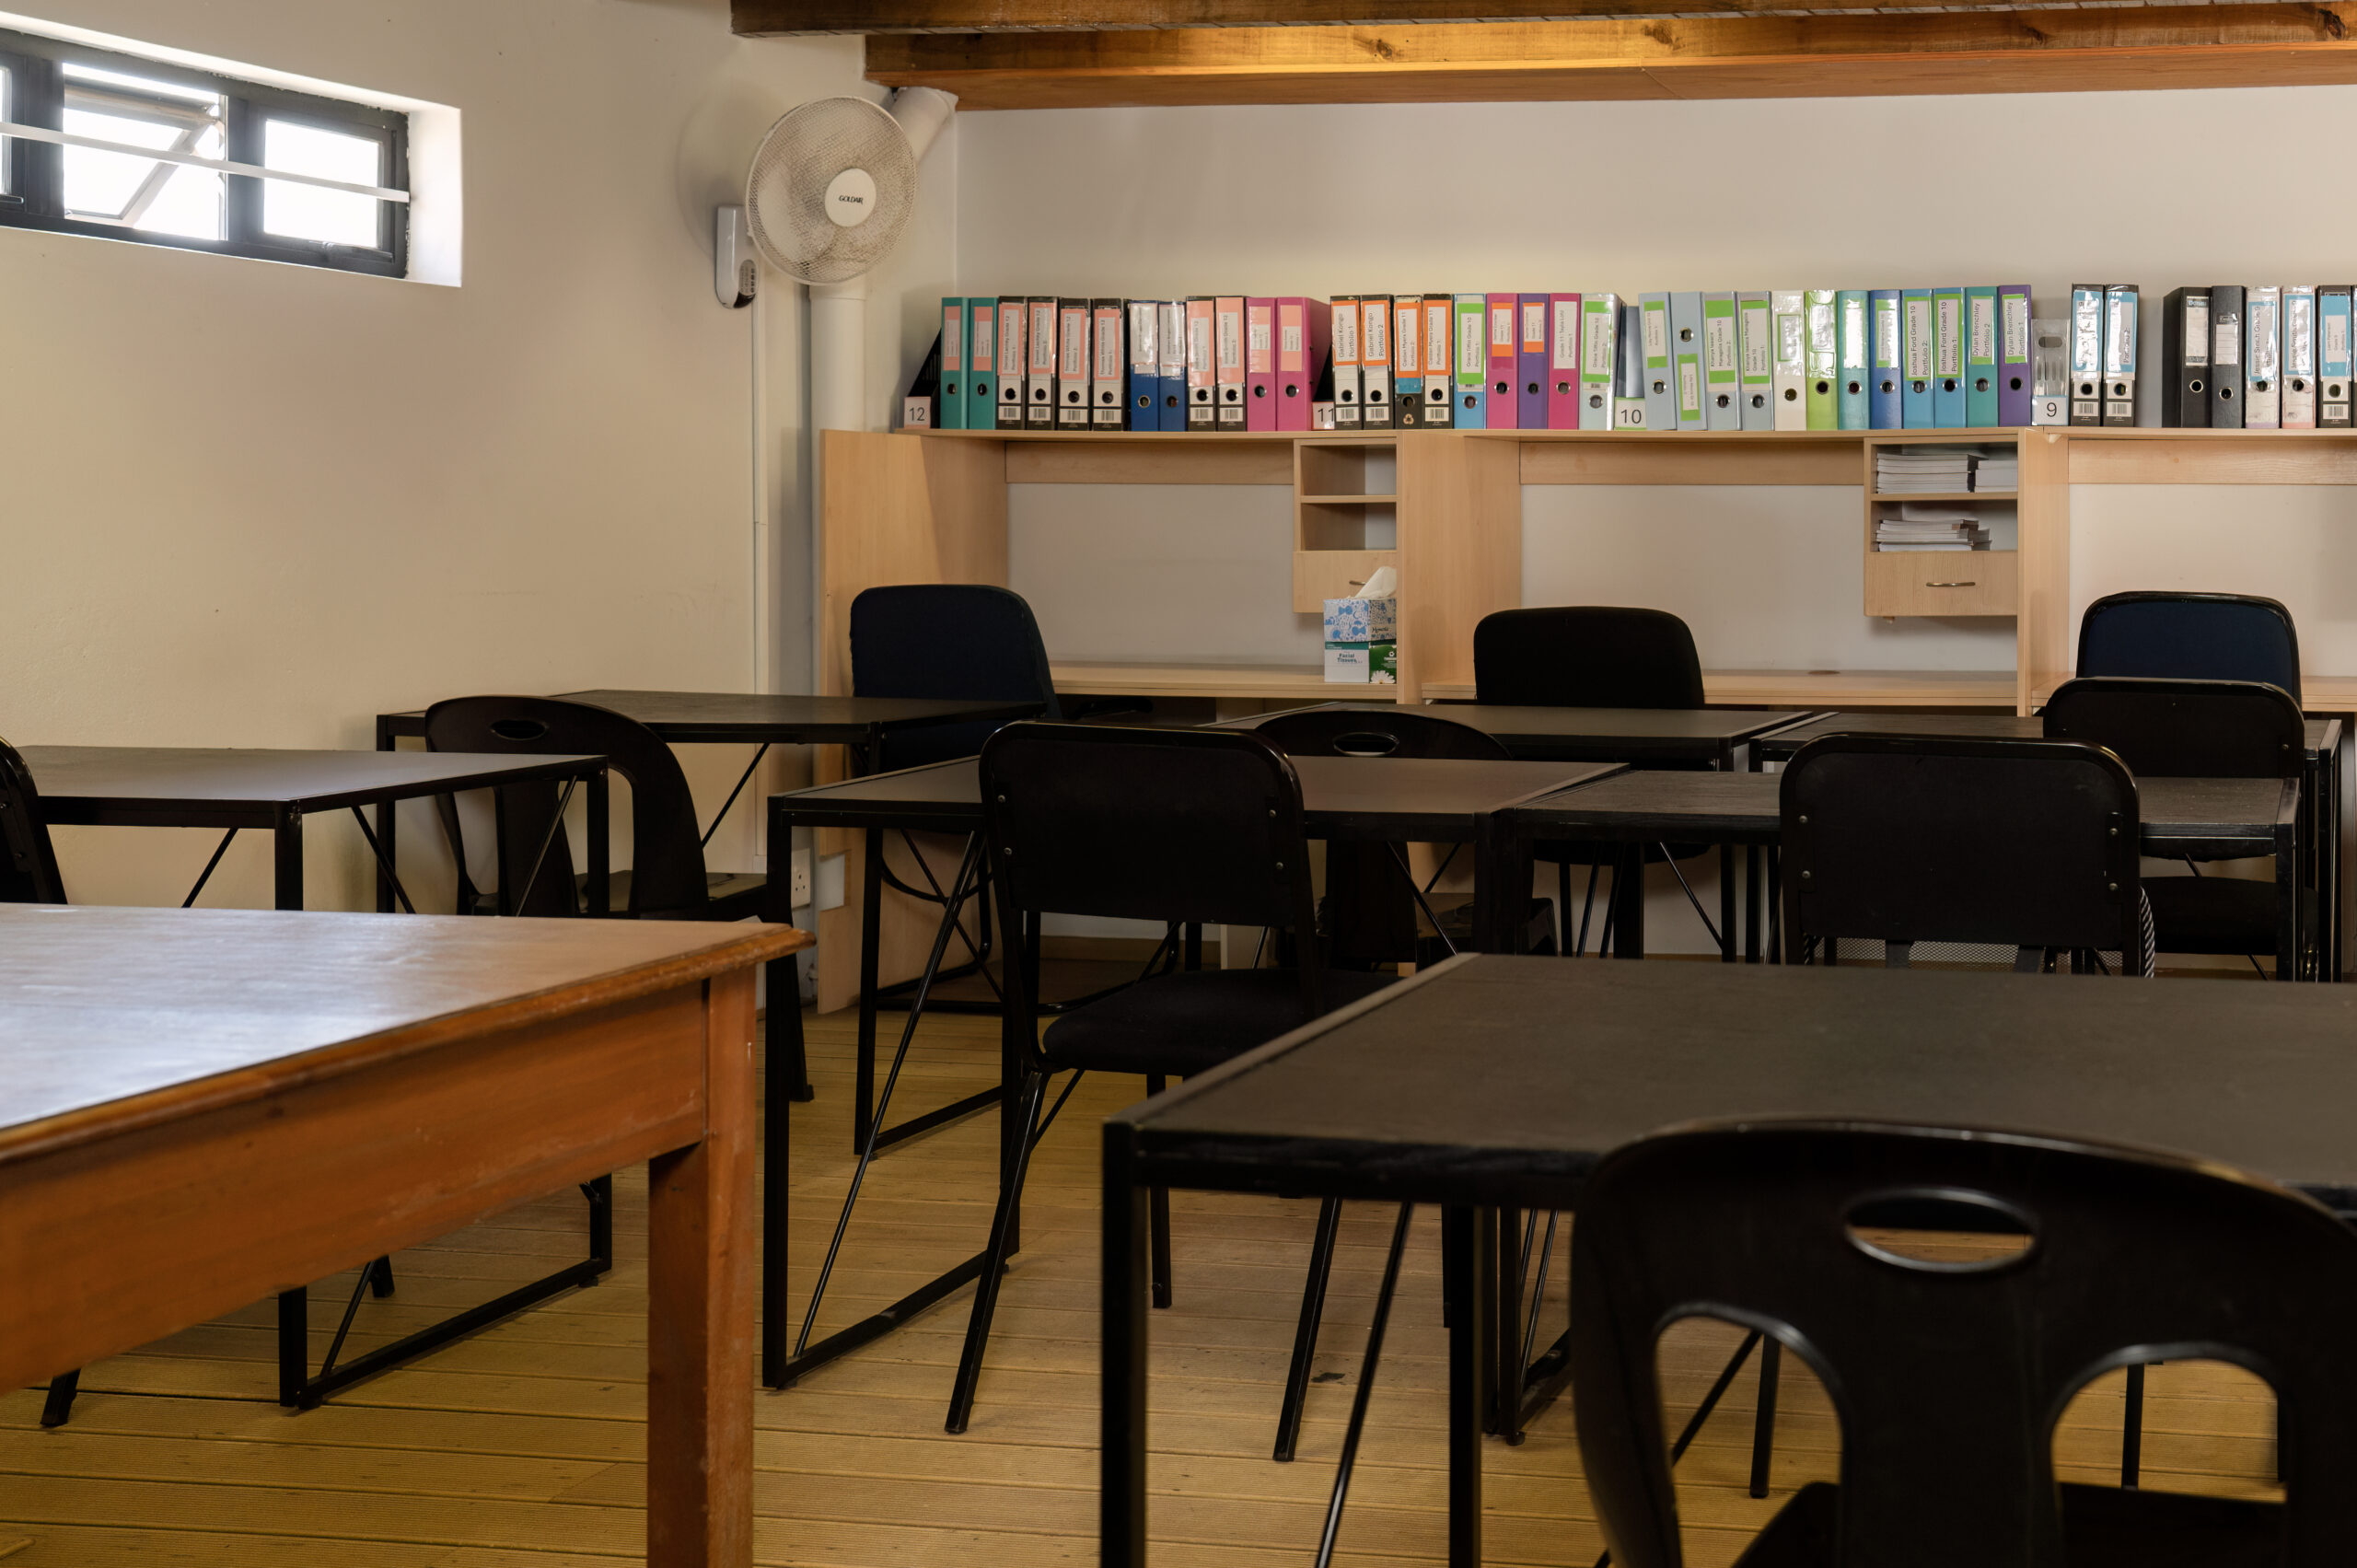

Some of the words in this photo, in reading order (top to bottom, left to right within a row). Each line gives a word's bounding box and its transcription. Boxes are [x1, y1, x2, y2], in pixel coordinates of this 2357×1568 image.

[839, 194, 864, 205] GOLDAIR
[909, 406, 925, 422] 12
[1620, 409, 1642, 424] 10
[2046, 401, 2058, 418] 9
